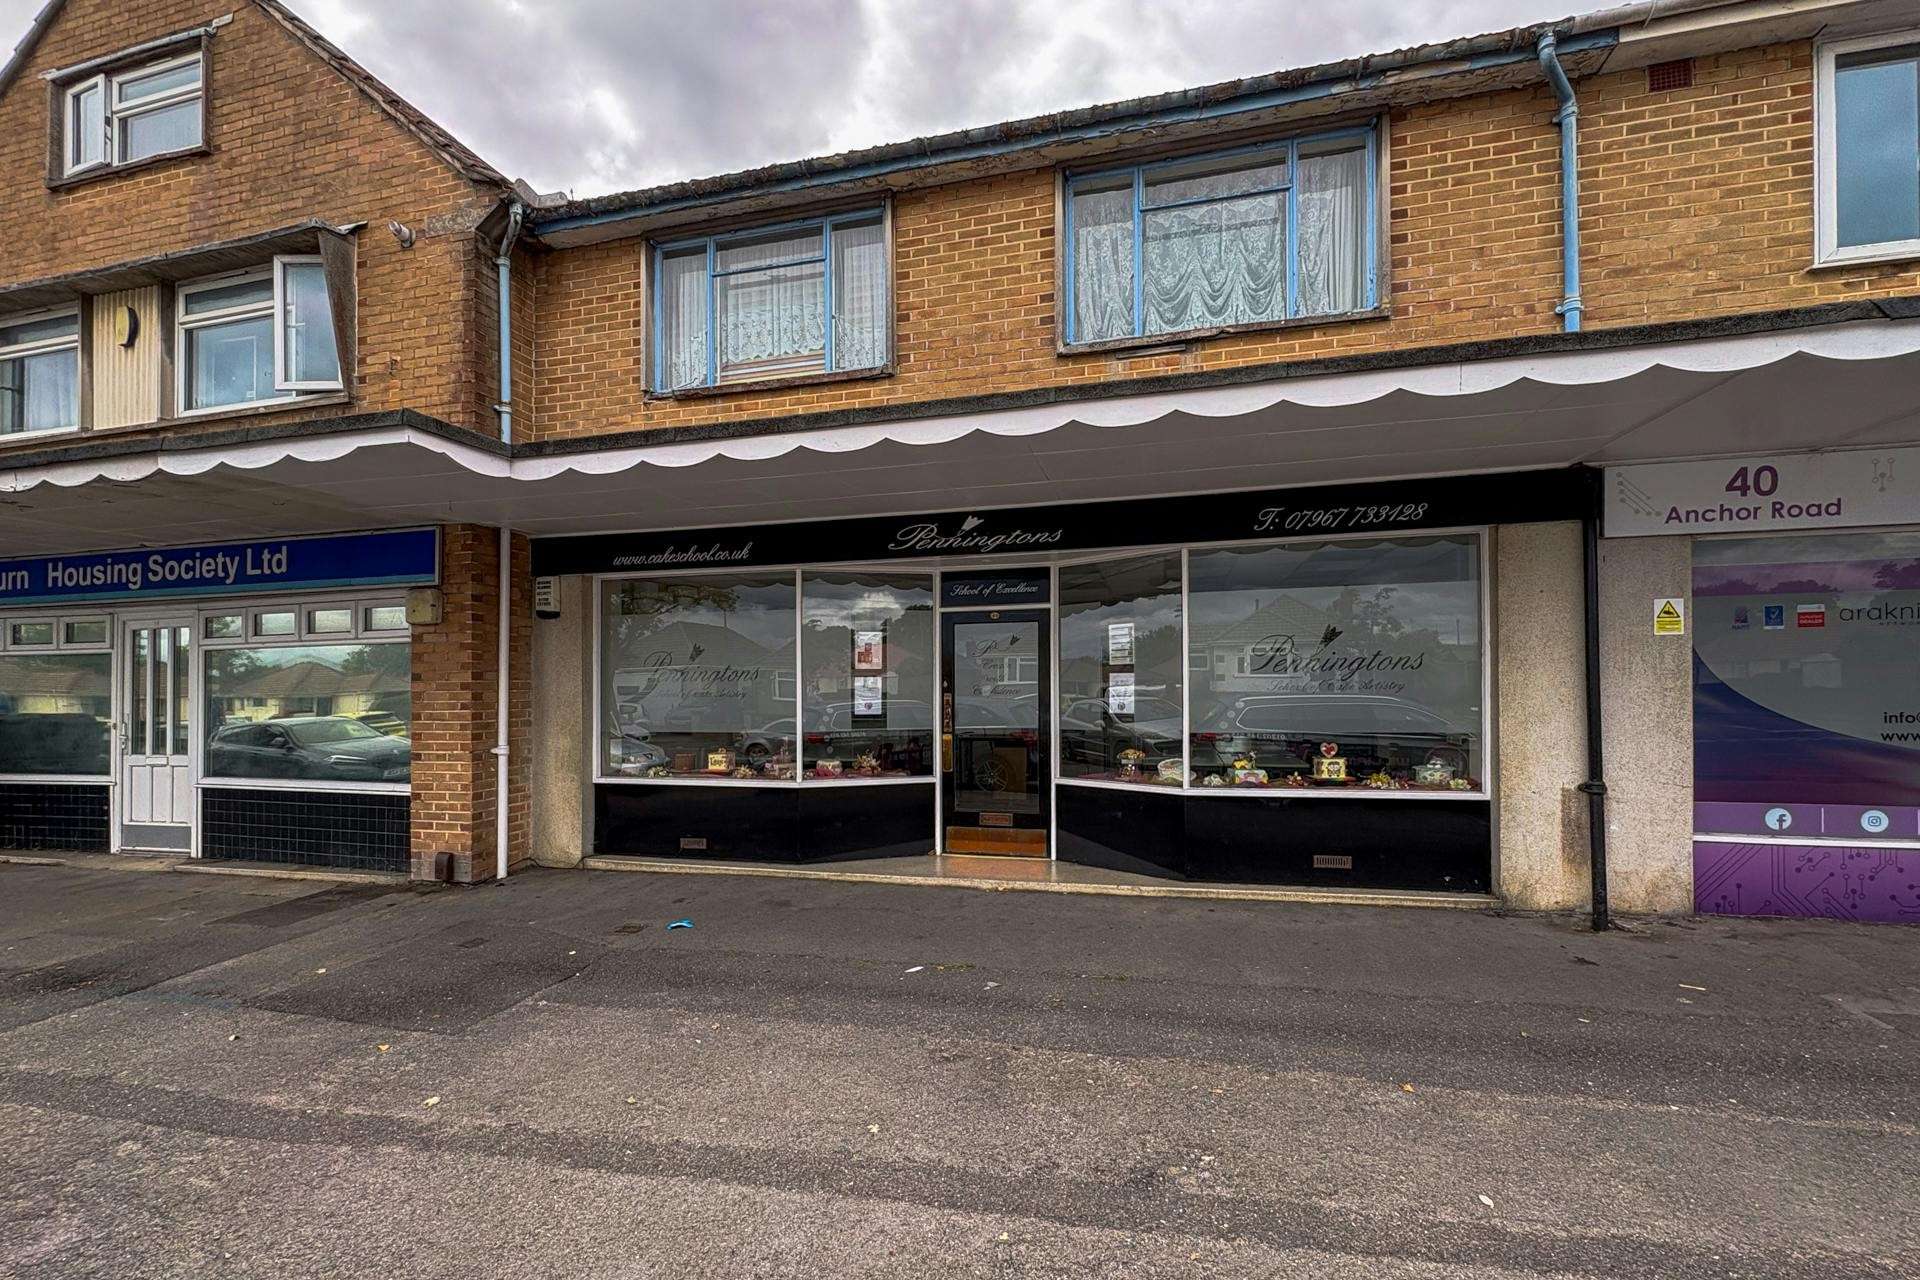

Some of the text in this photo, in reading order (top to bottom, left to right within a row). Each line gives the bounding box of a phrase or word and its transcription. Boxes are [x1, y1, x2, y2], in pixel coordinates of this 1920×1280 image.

[1725, 465, 1778, 497] 40
[1284, 508, 1350, 530] 07967
[1347, 502, 1429, 527] 733128
[1664, 498, 1842, 524] Anchor Road
[887, 523, 1063, 552] Penningtons
[47, 558, 142, 589] Housing
[147, 552, 240, 584] Society
[246, 546, 287, 576] Ltd
[612, 541, 753, 566] www.cakeschool.co.uk
[949, 581, 1039, 597] School of Excellence
[1250, 633, 1425, 681] Penningtons
